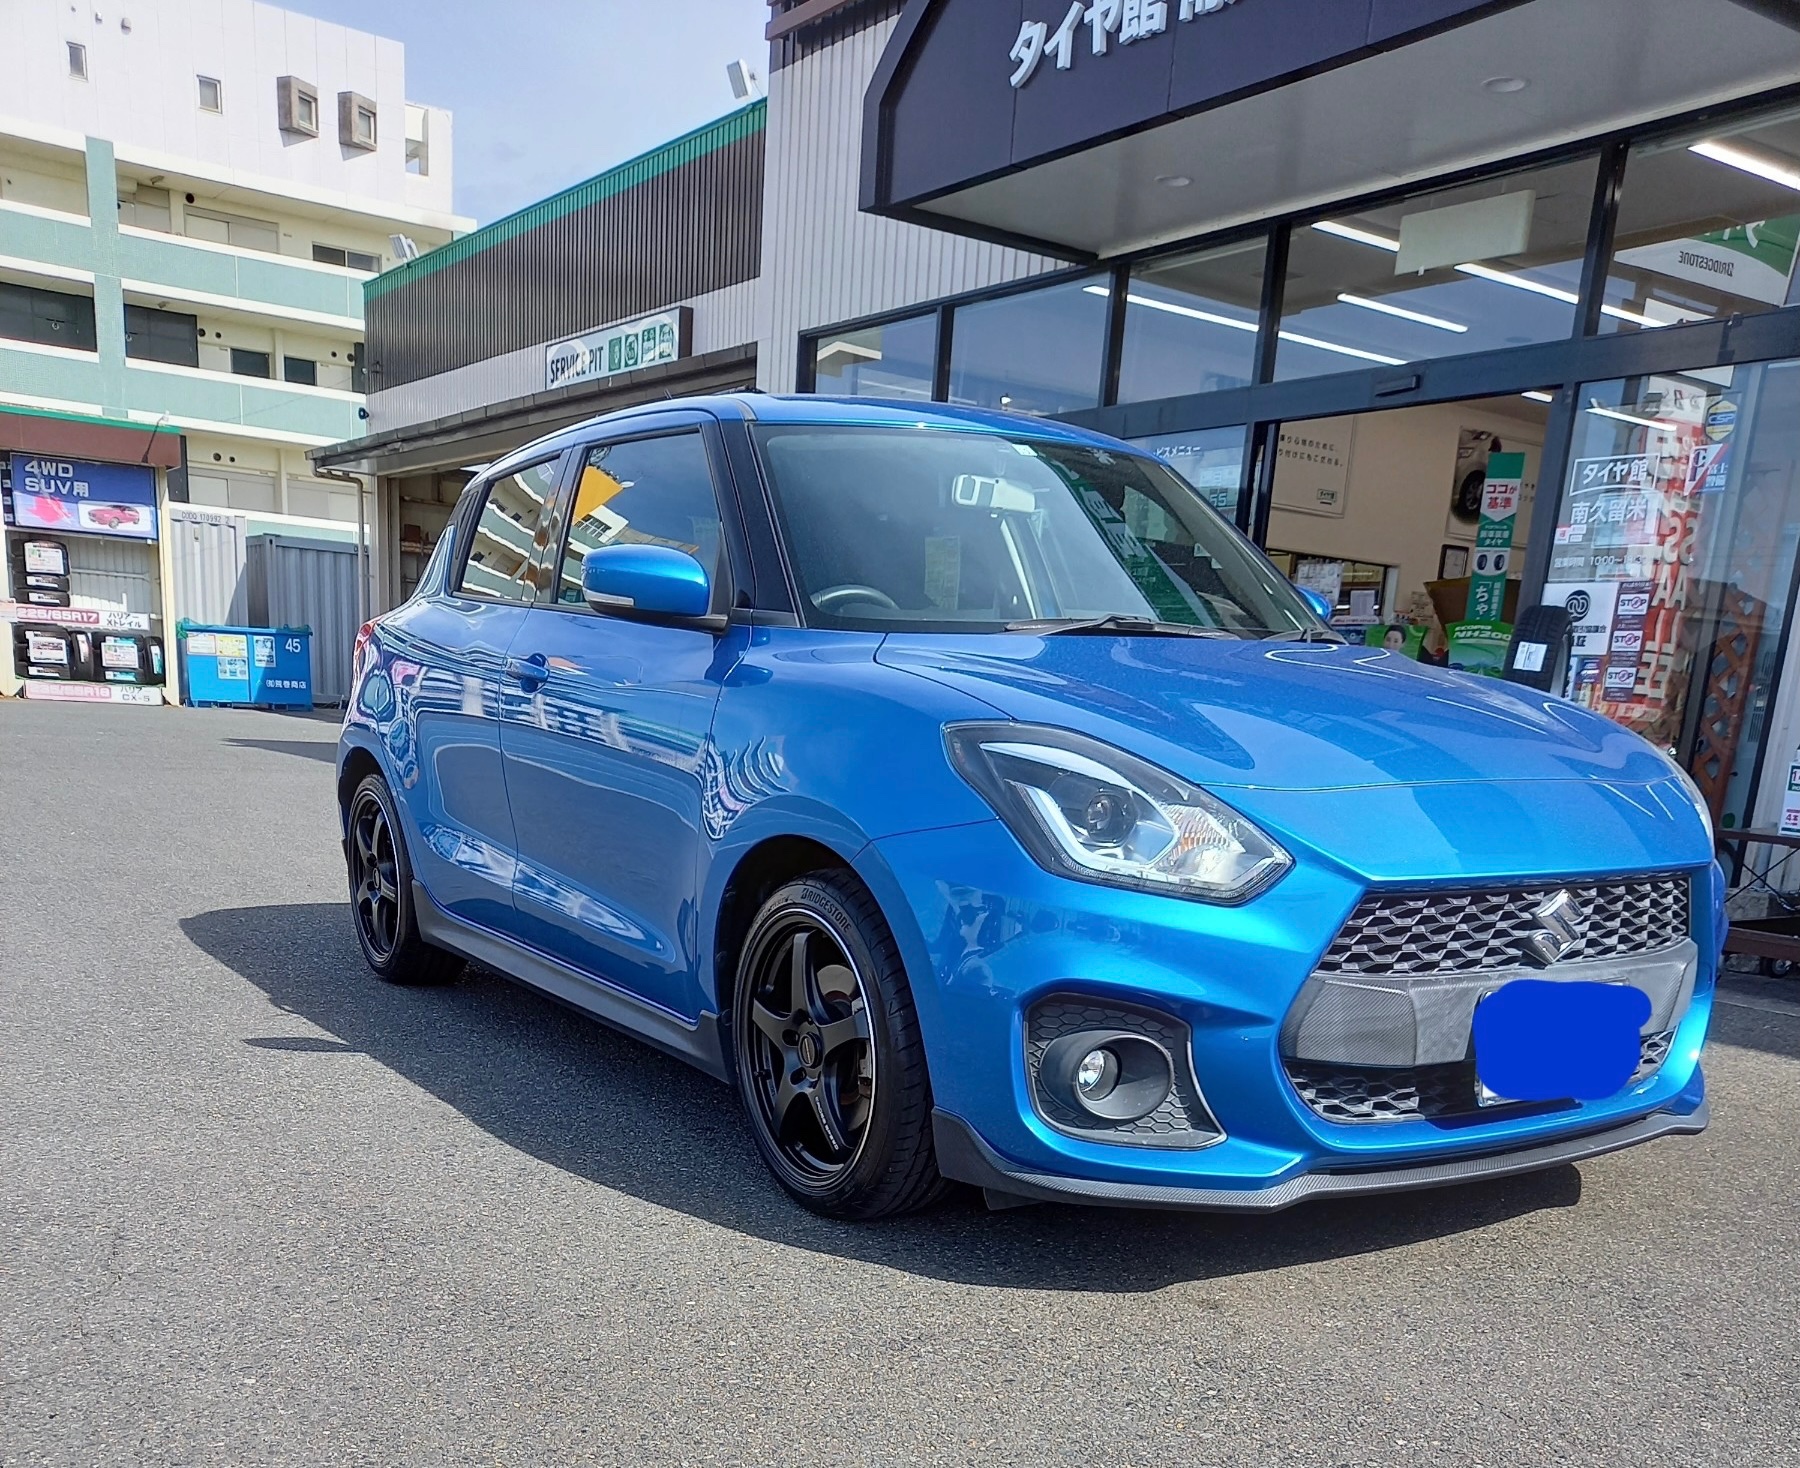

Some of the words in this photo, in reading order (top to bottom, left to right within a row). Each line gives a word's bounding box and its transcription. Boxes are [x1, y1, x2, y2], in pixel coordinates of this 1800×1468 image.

[1009, 0, 1168, 88] タイヤ館
[550, 352, 587, 383] SERVICE
[589, 346, 604, 373] PIT
[25, 460, 73, 478] 4WD
[1583, 459, 1649, 485] タイヤ館
[24, 477, 89, 498] SUV用
[1486, 484, 1518, 495] ココが
[1487, 496, 1513, 510] 基準
[1571, 496, 1648, 526] 南久留米
[285, 638, 301, 653] 45
[122, 692, 150, 702] CX-5
[800, 887, 852, 933] BRIDGESTONE
